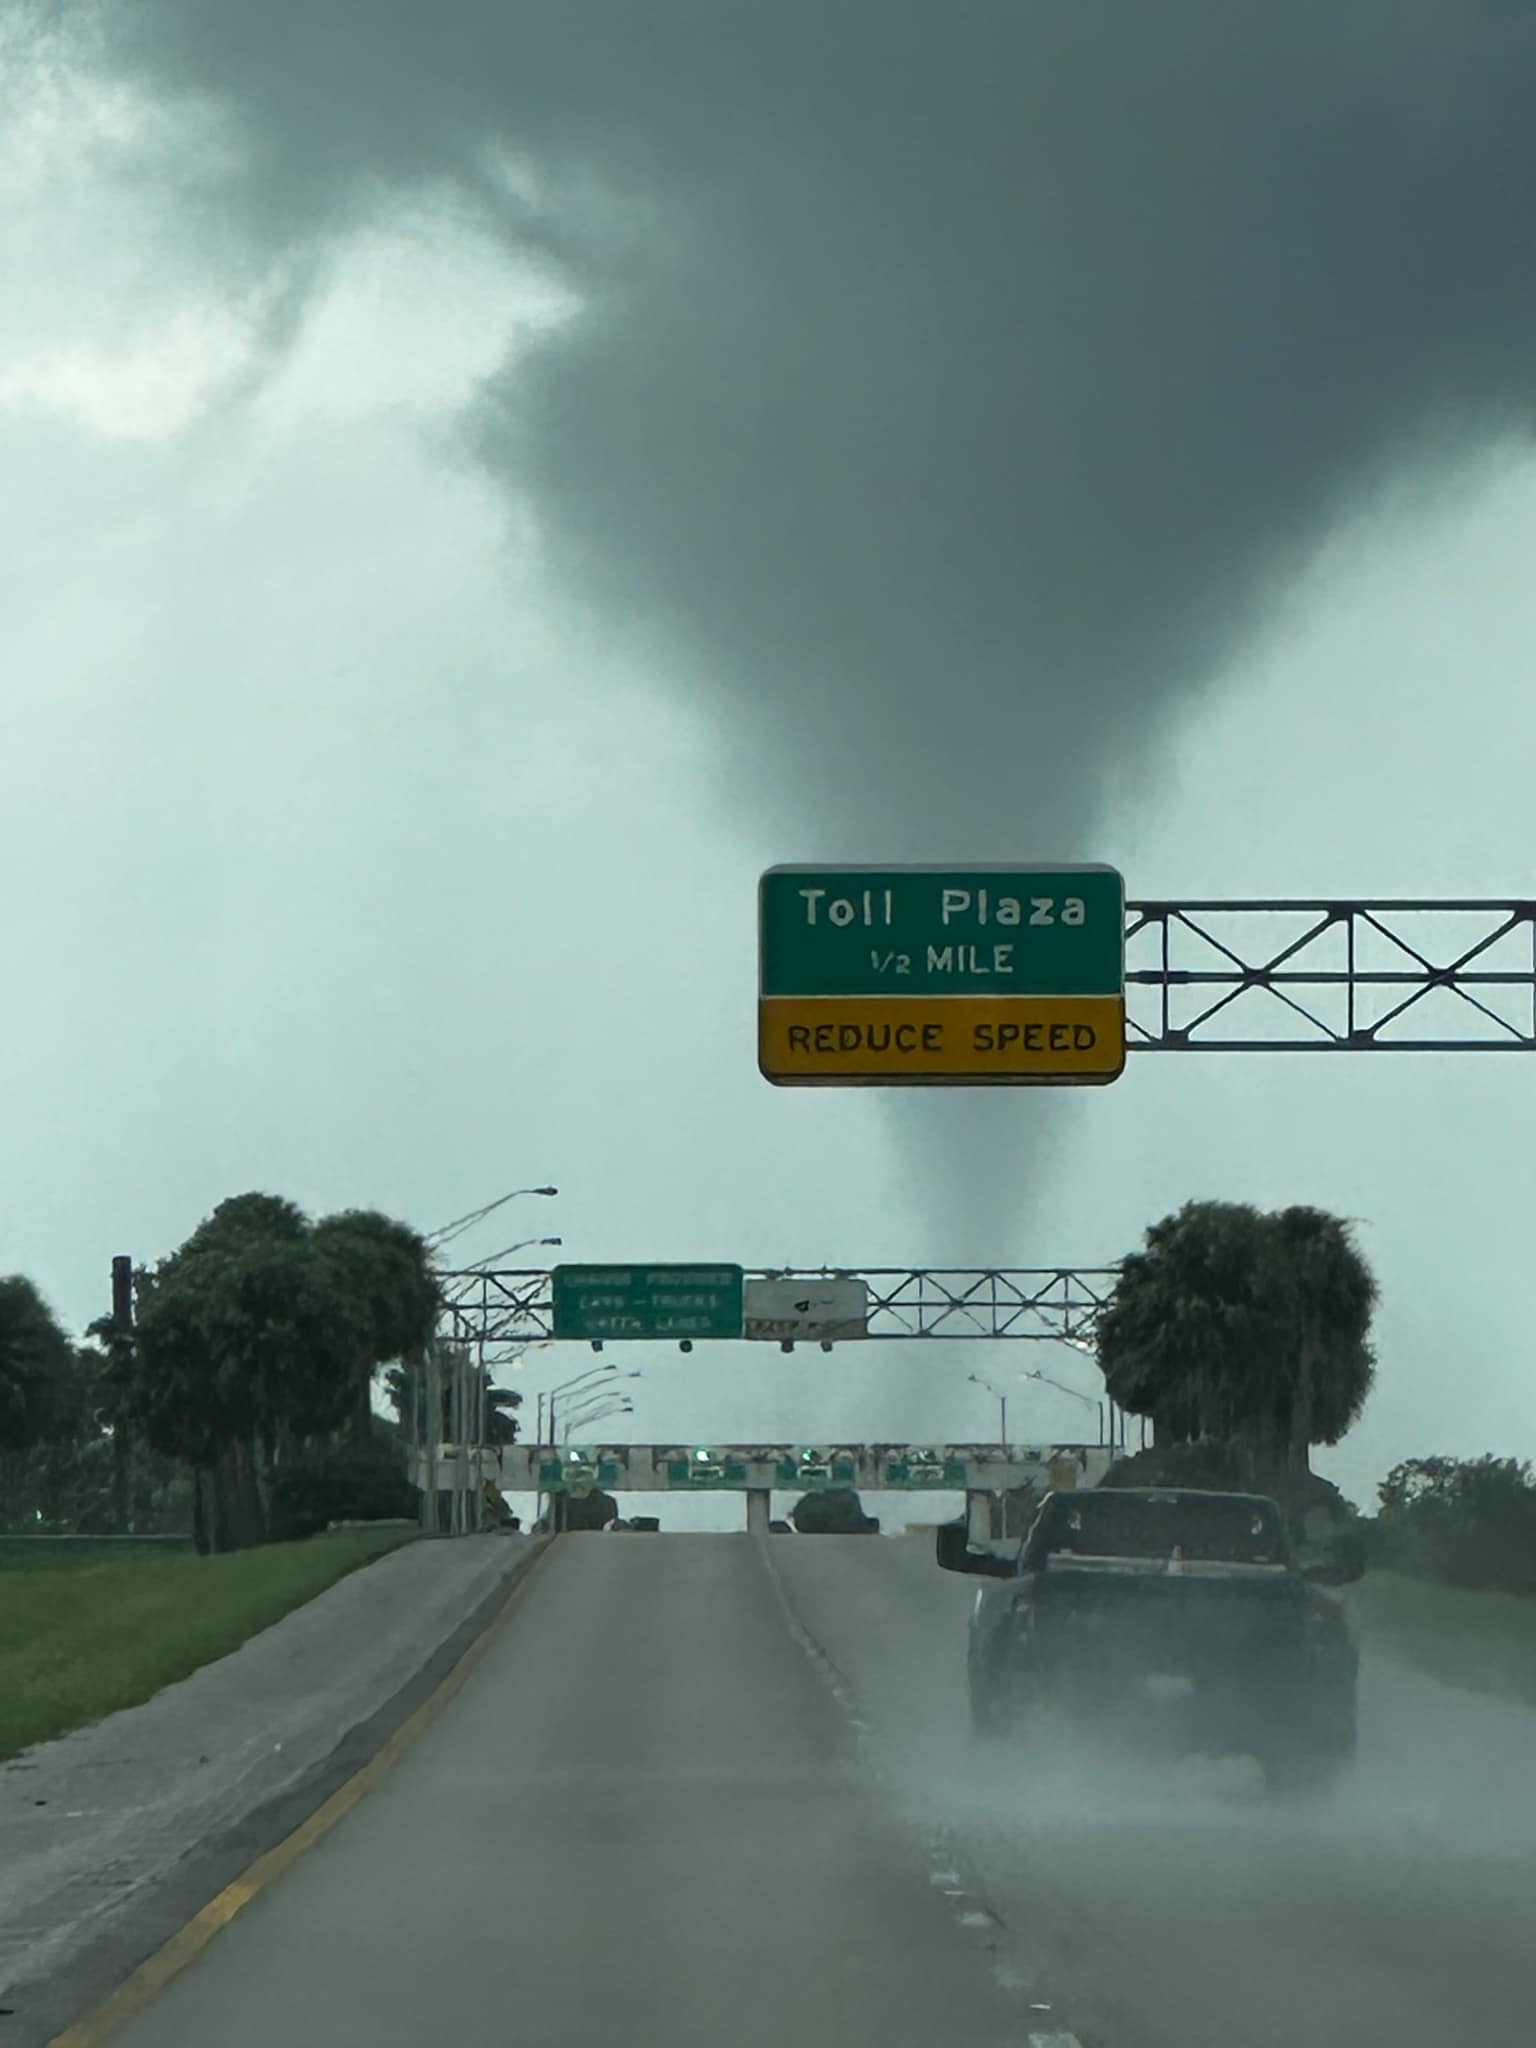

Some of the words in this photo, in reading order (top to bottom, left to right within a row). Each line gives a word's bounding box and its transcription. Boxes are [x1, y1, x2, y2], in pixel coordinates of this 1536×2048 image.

[799, 889, 891, 925] Toll
[942, 889, 1085, 925] Plaza
[927, 945, 1014, 973] MILE
[788, 1025, 942, 1052] REDUCE
[974, 1024, 1096, 1051] SPEED
